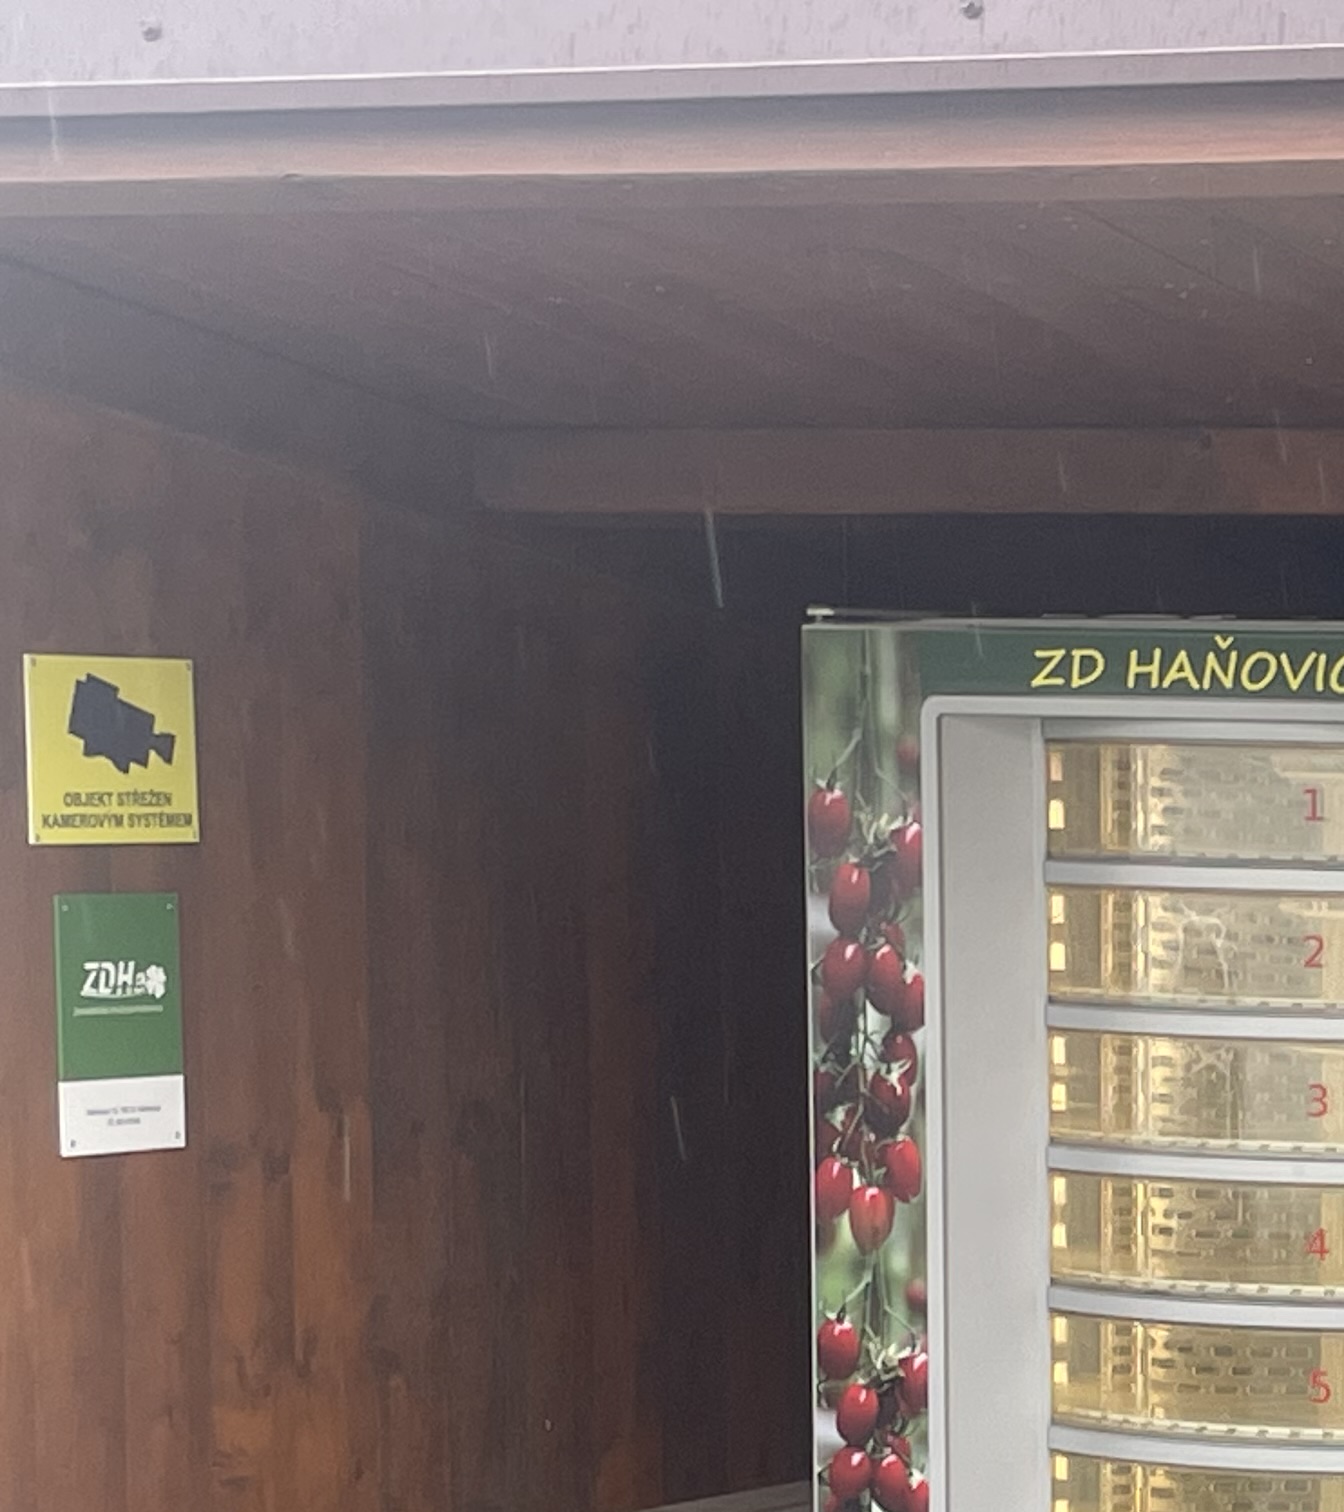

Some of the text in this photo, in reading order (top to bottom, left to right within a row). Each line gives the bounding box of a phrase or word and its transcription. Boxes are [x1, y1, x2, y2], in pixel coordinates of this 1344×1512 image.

[1030, 648, 1105, 688] ZD
[63, 788, 173, 807] OBJEKT STŘEŽEN
[1303, 788, 1325, 821] 1
[41, 809, 193, 828] KAMEROVÝM SYSTÉMEM
[1303, 935, 1324, 968] 2
[1307, 1083, 1329, 1117] 3
[1305, 1227, 1330, 1261] 4
[1309, 1369, 1332, 1404] 5
